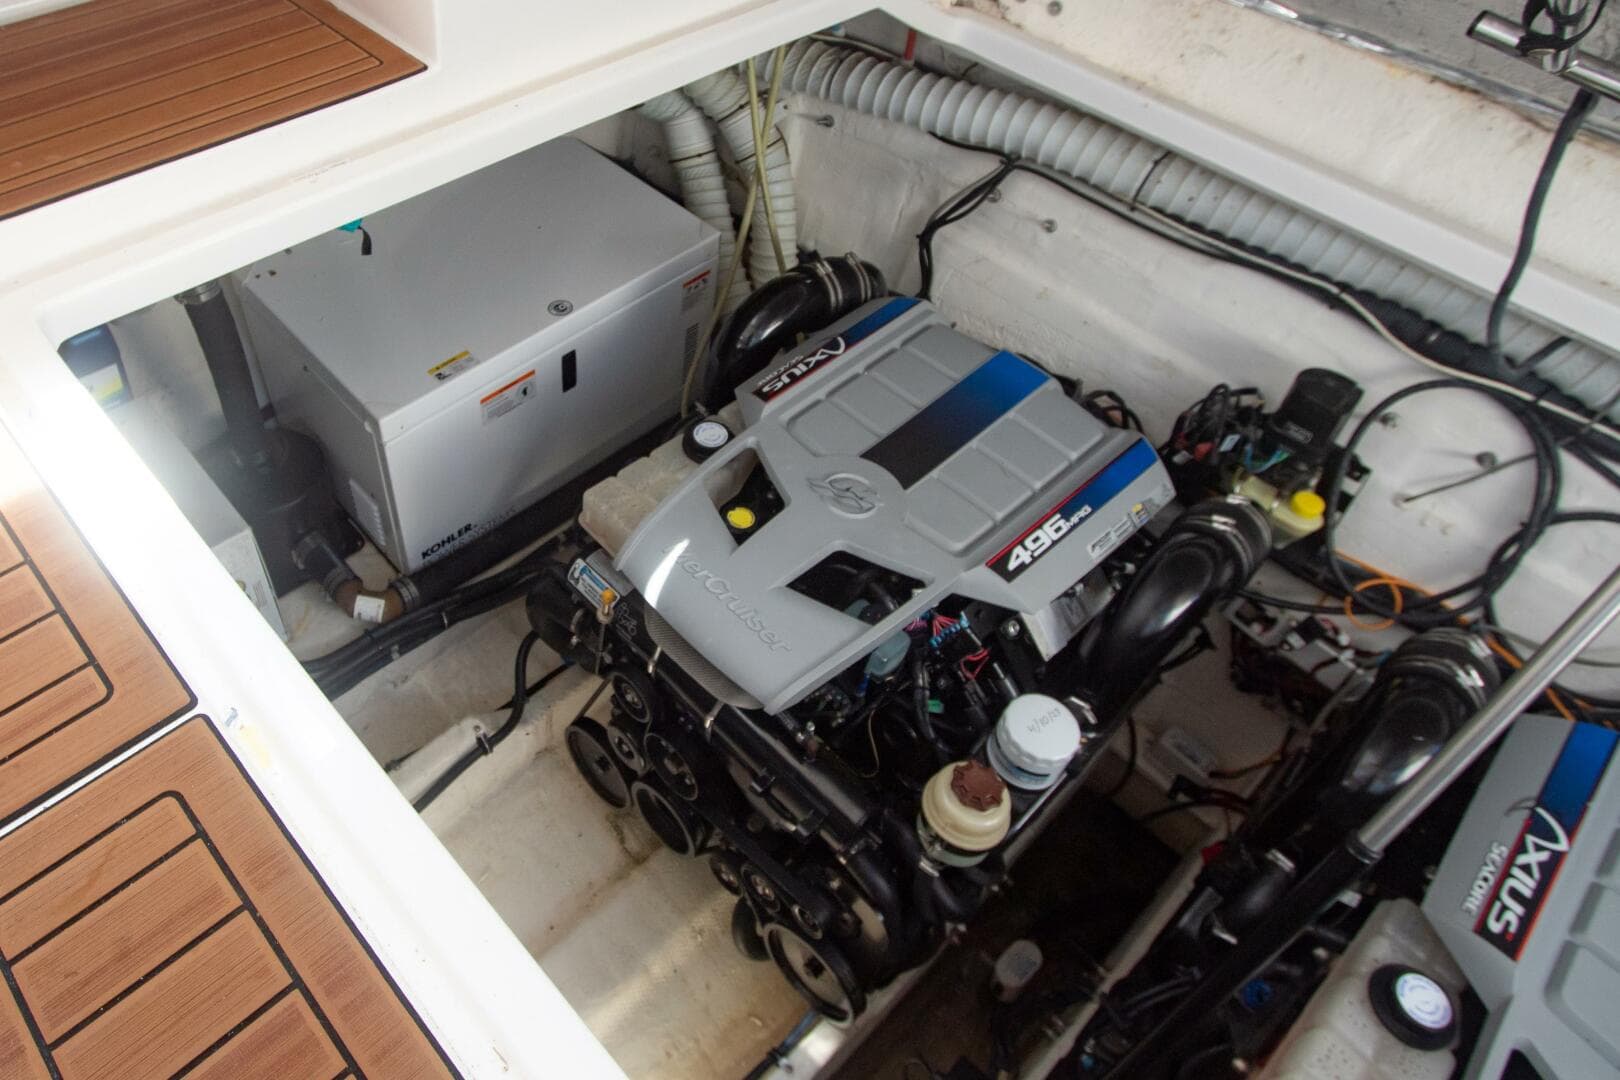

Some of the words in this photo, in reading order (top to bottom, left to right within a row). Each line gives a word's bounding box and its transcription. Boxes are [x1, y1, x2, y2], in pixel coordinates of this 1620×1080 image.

[761, 336, 846, 393] AXIUS
[421, 523, 472, 560] KOHLER
[1007, 513, 1067, 572] 496
[1066, 504, 1093, 529] MAG
[661, 548, 792, 652] erCruiser
[1461, 842, 1509, 916] SEACORE
[1486, 806, 1570, 934] AXIUS
